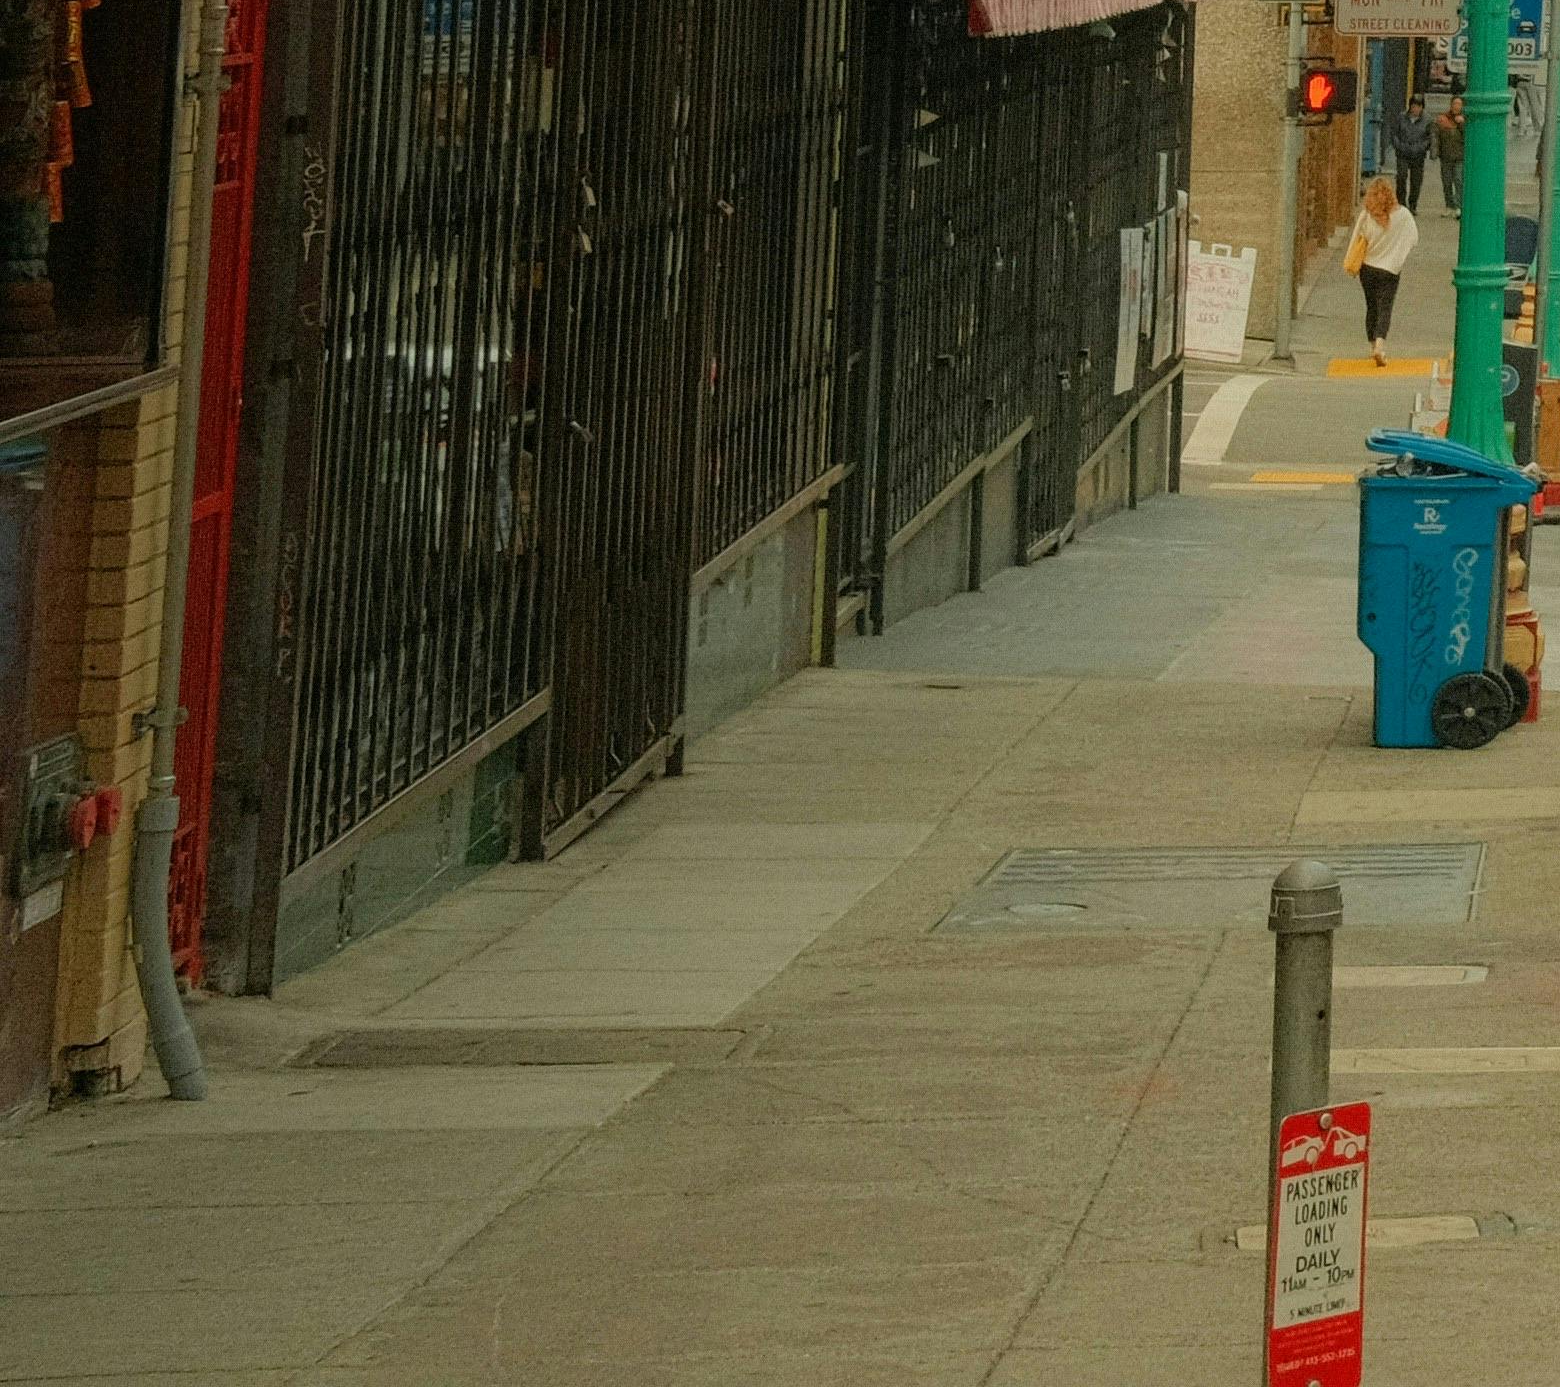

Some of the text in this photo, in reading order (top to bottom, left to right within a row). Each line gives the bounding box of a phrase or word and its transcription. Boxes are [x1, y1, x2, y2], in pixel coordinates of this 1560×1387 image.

[1286, 1169, 1359, 1203] PASSENGER
[1295, 1195, 1348, 1225] LOADING
[1305, 1222, 1336, 1248] ONLY
[1296, 1247, 1341, 1274] DAILY
